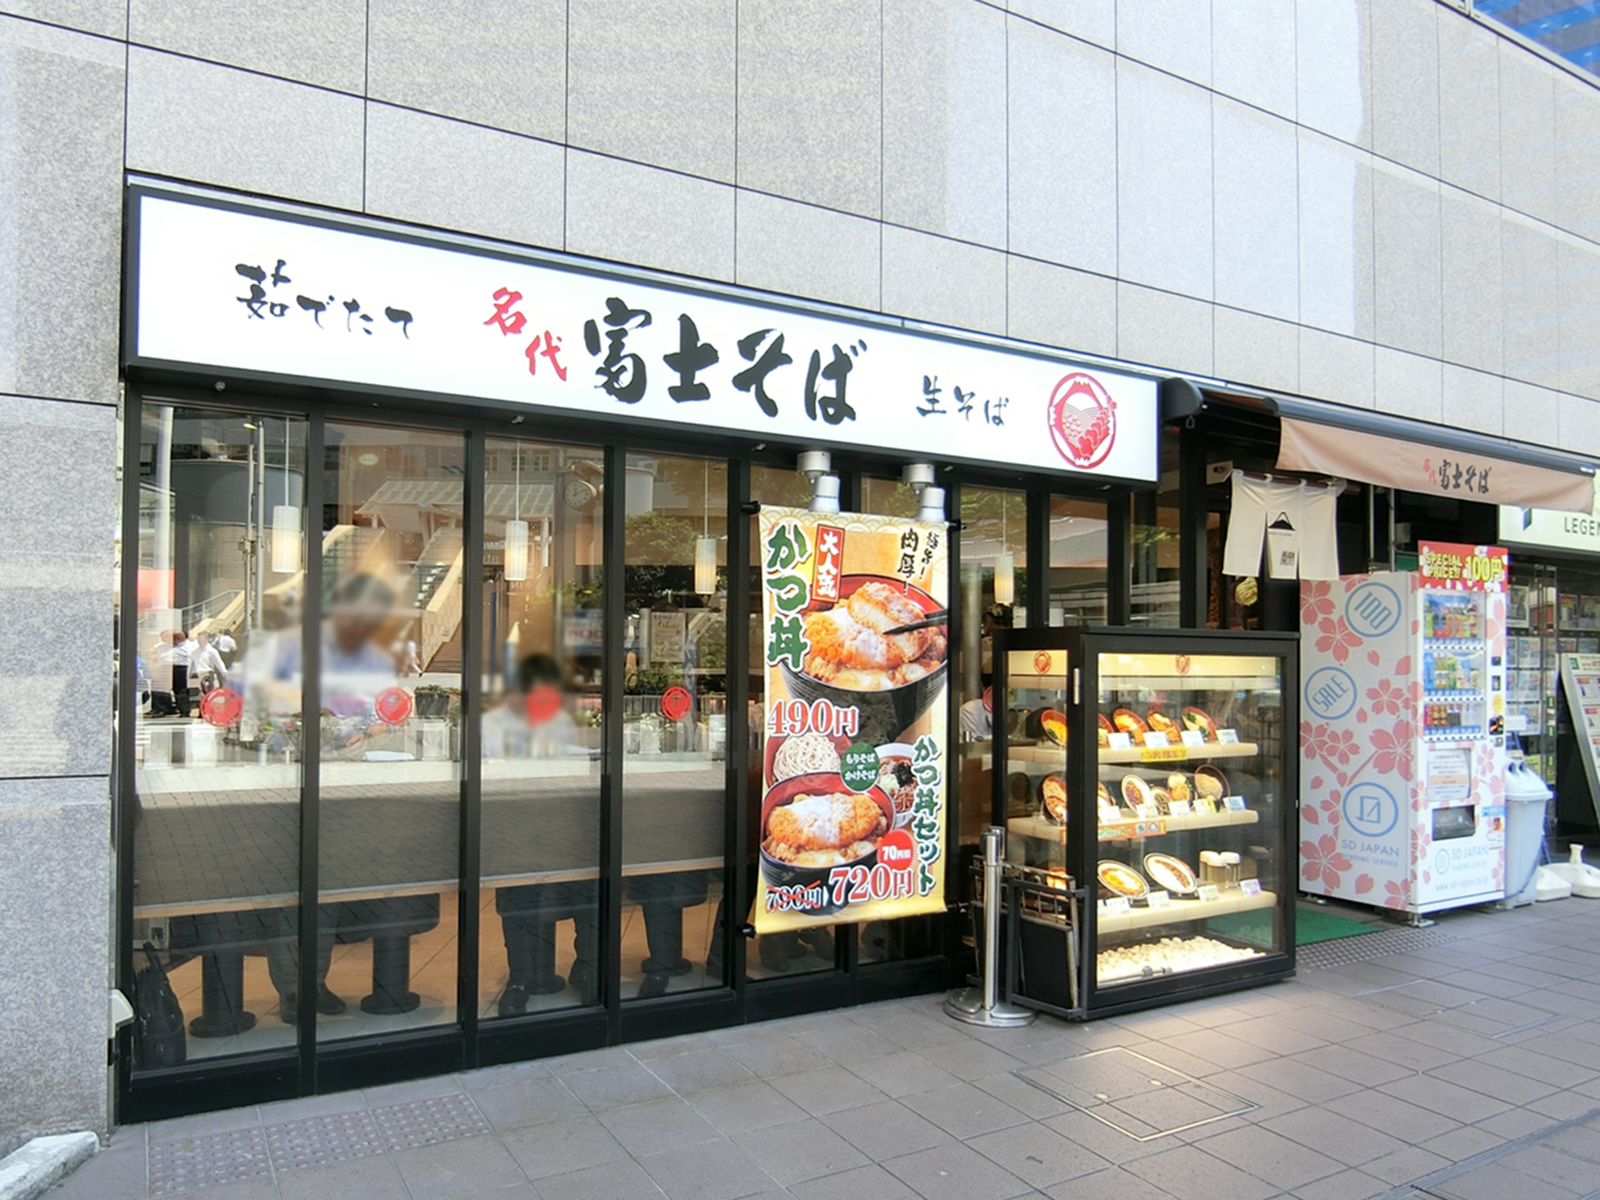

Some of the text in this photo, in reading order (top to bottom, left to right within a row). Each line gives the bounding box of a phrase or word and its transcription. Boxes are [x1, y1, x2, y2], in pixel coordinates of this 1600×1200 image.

[235, 260, 413, 339] 茹でたて
[917, 376, 1009, 426] 生そば
[818, 531, 840, 598] 大人気
[1426, 553, 1462, 567] SPECIAL
[1465, 555, 1504, 582] 100円
[766, 524, 811, 669] かつ丼
[1312, 674, 1350, 712] SALE
[767, 699, 858, 736] 490円
[914, 737, 940, 895] かつ丼セット
[1341, 839, 1399, 857] SD JAPAN
[1372, 857, 1398, 868] SERVICE
[829, 864, 914, 905] 720円
